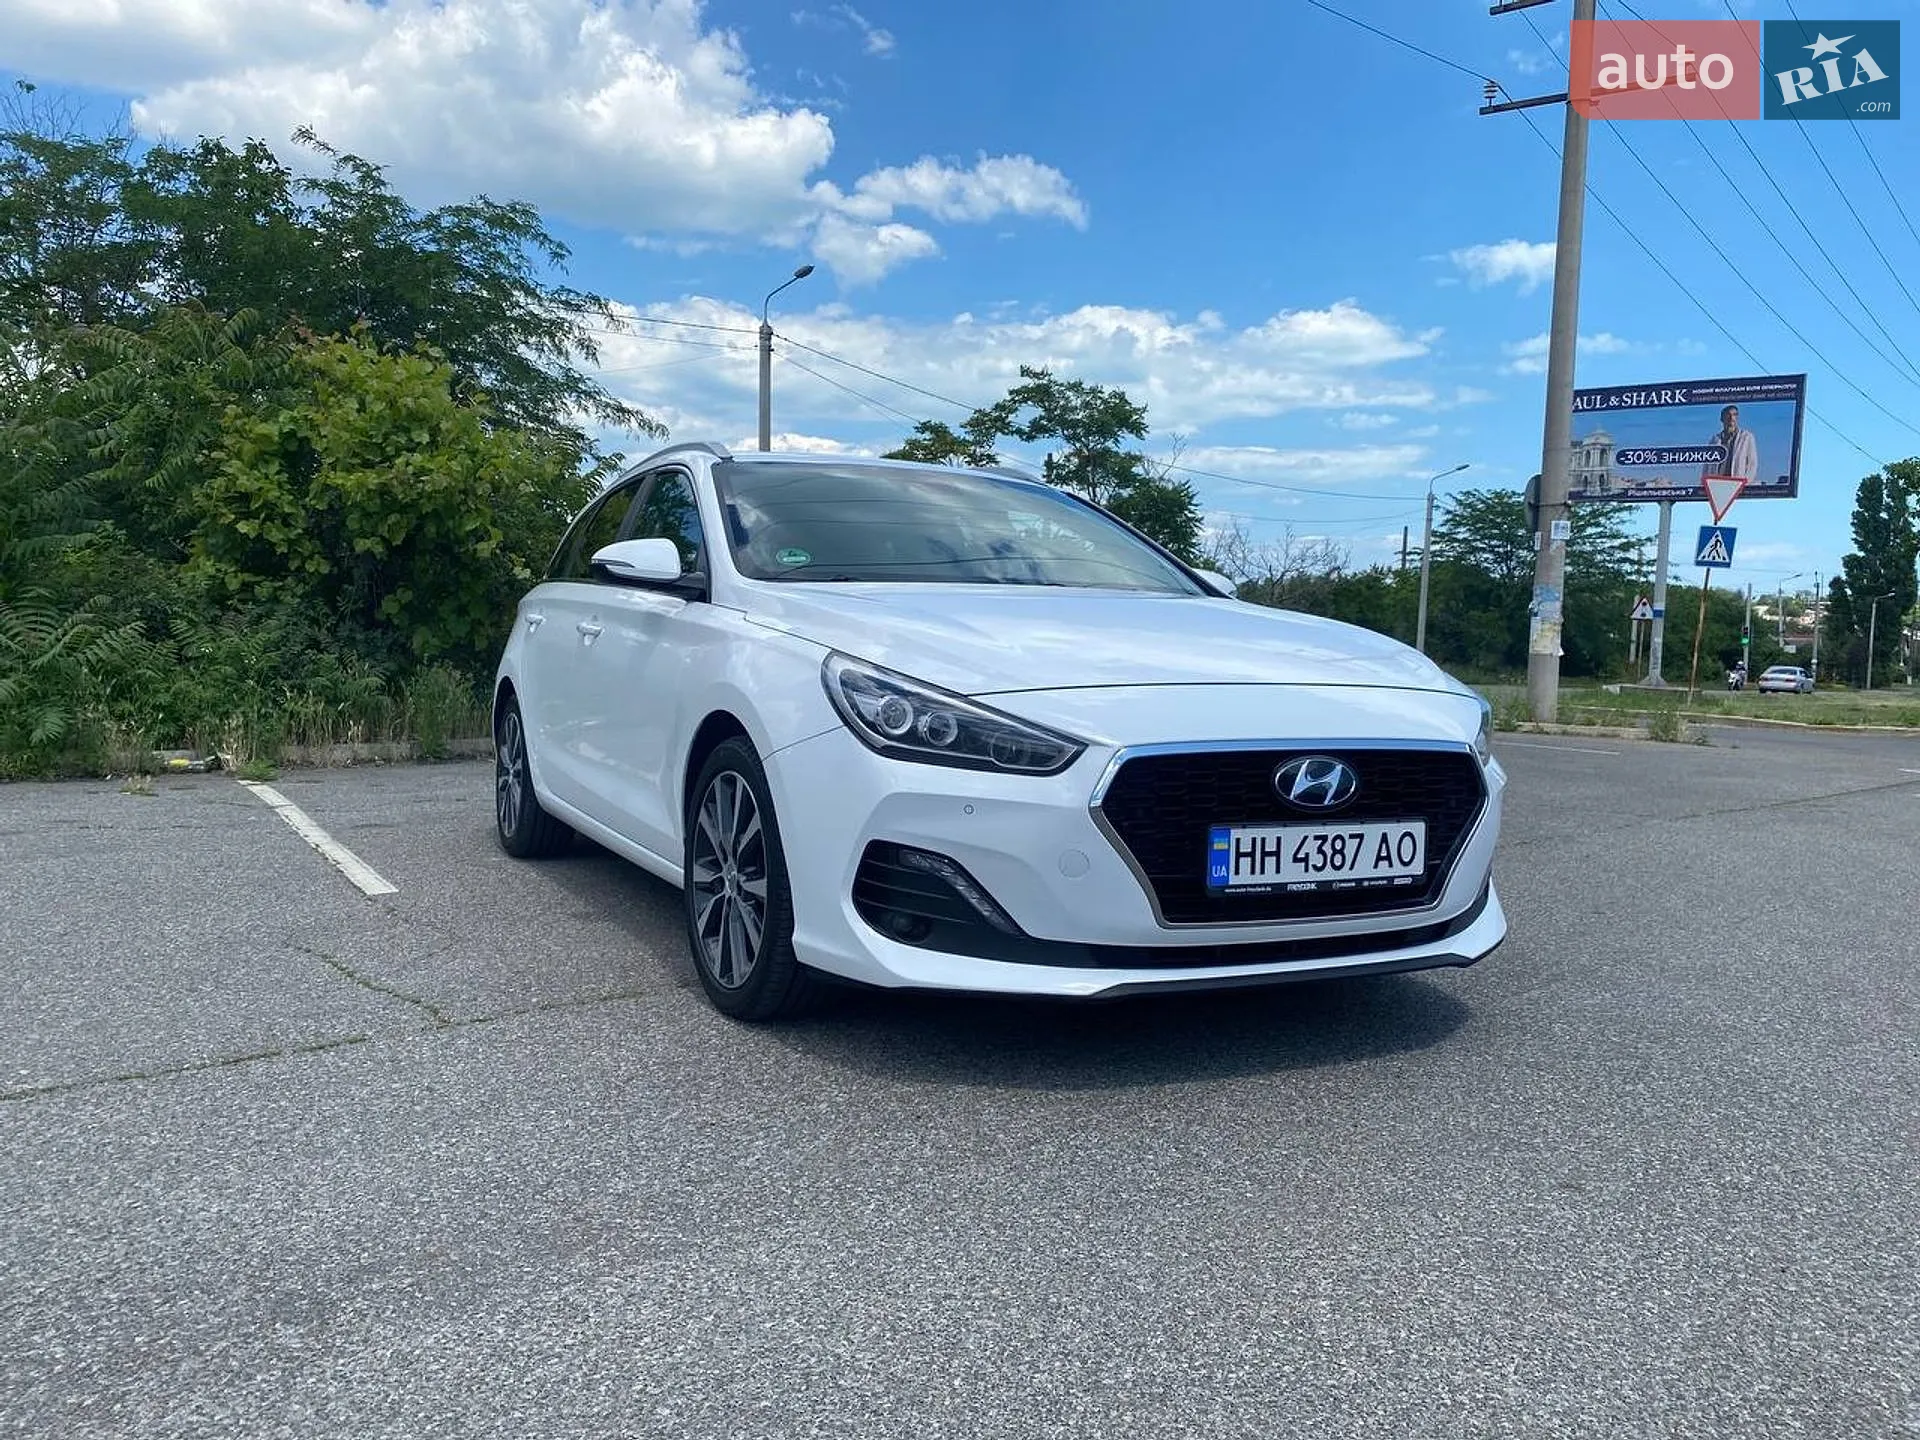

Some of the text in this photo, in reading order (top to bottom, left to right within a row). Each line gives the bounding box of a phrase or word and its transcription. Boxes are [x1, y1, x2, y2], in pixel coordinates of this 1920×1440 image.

[1572, 395, 1607, 410] AUL
[1609, 396, 1620, 407] &
[1621, 388, 1687, 407] SHARK
[1620, 450, 1721, 464] -30% ЗНИЖКА
[1234, 831, 1417, 876] HH 4387 AO
[1212, 865, 1228, 878] UA
